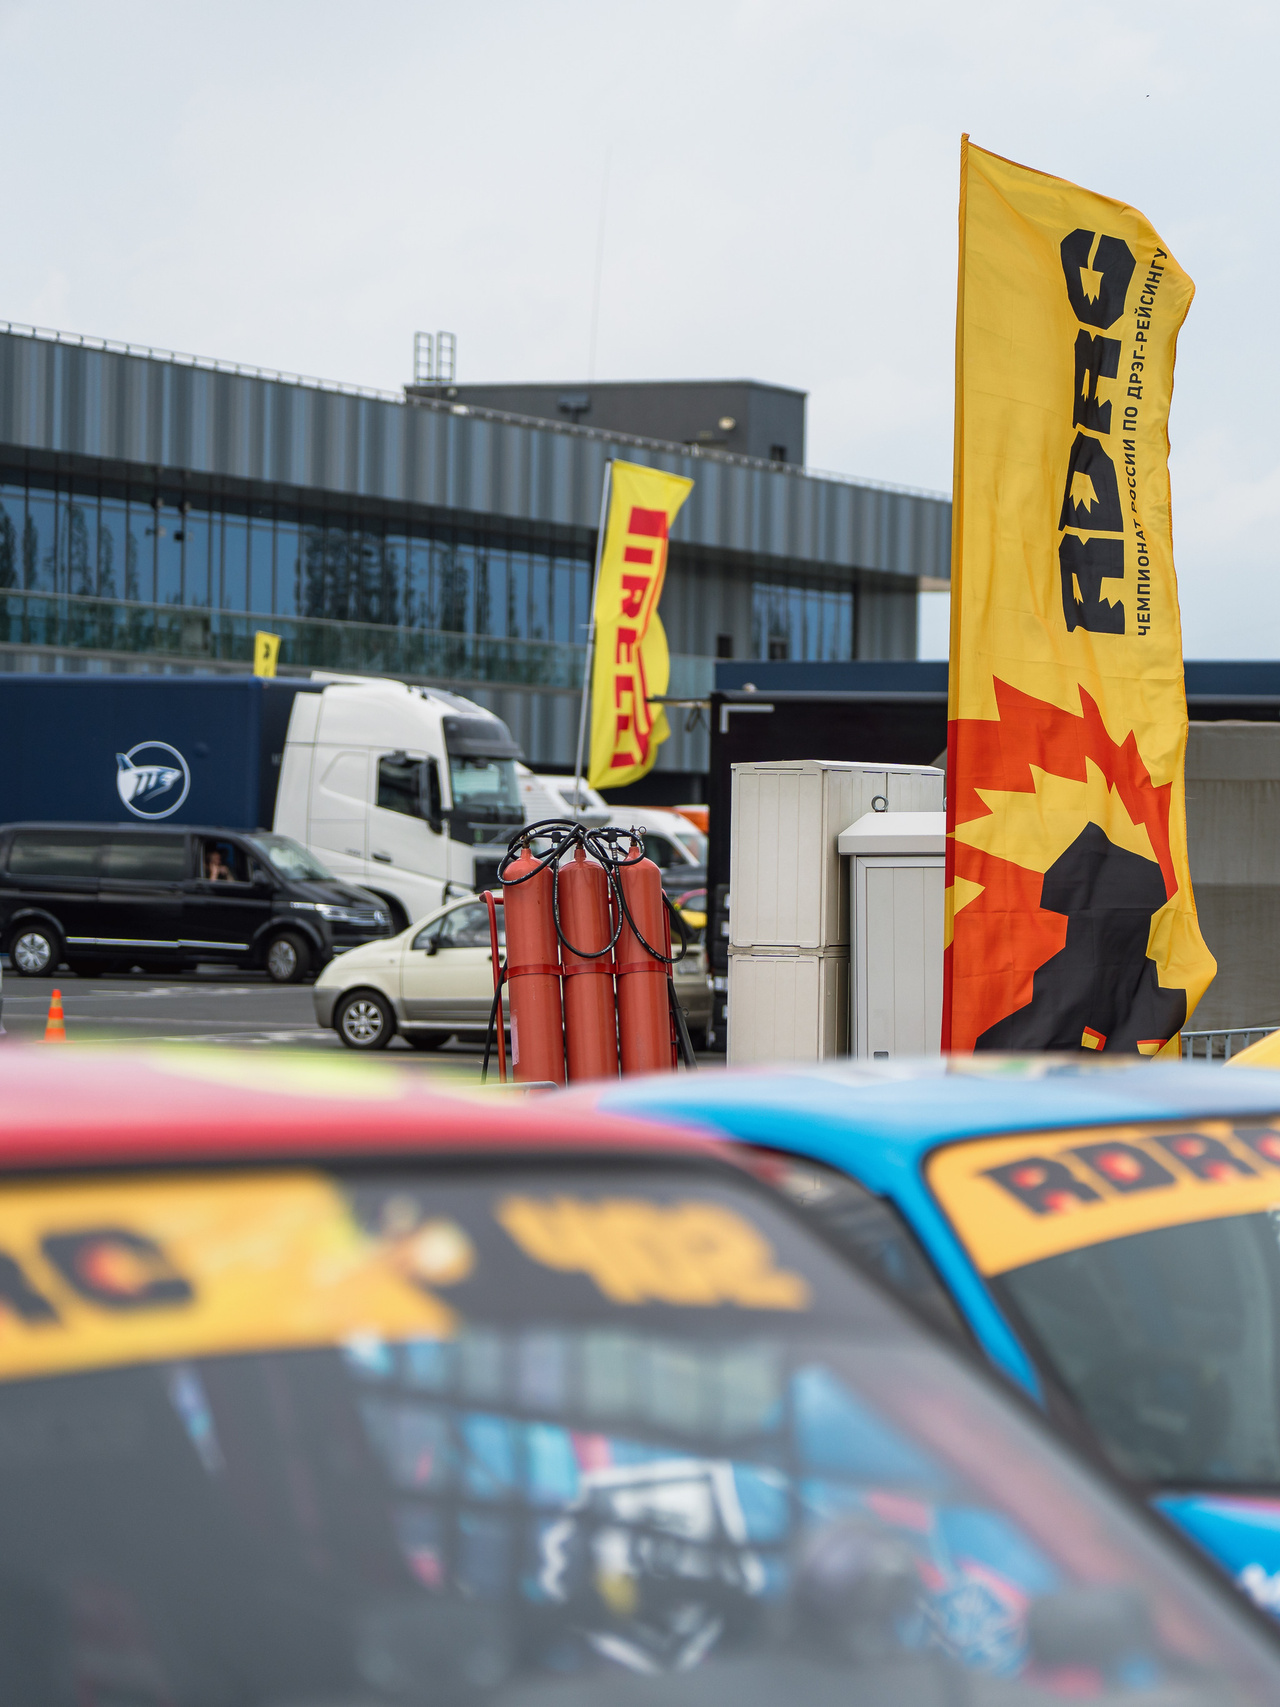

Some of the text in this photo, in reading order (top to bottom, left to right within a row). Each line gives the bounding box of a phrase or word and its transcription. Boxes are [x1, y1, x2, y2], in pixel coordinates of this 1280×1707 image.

[1058, 228, 1137, 635] RDRG
[1122, 247, 1168, 636] ЧЕМПИОНАТ РОССИИ ПО ДРЭГ-РЕЙСИНГУ
